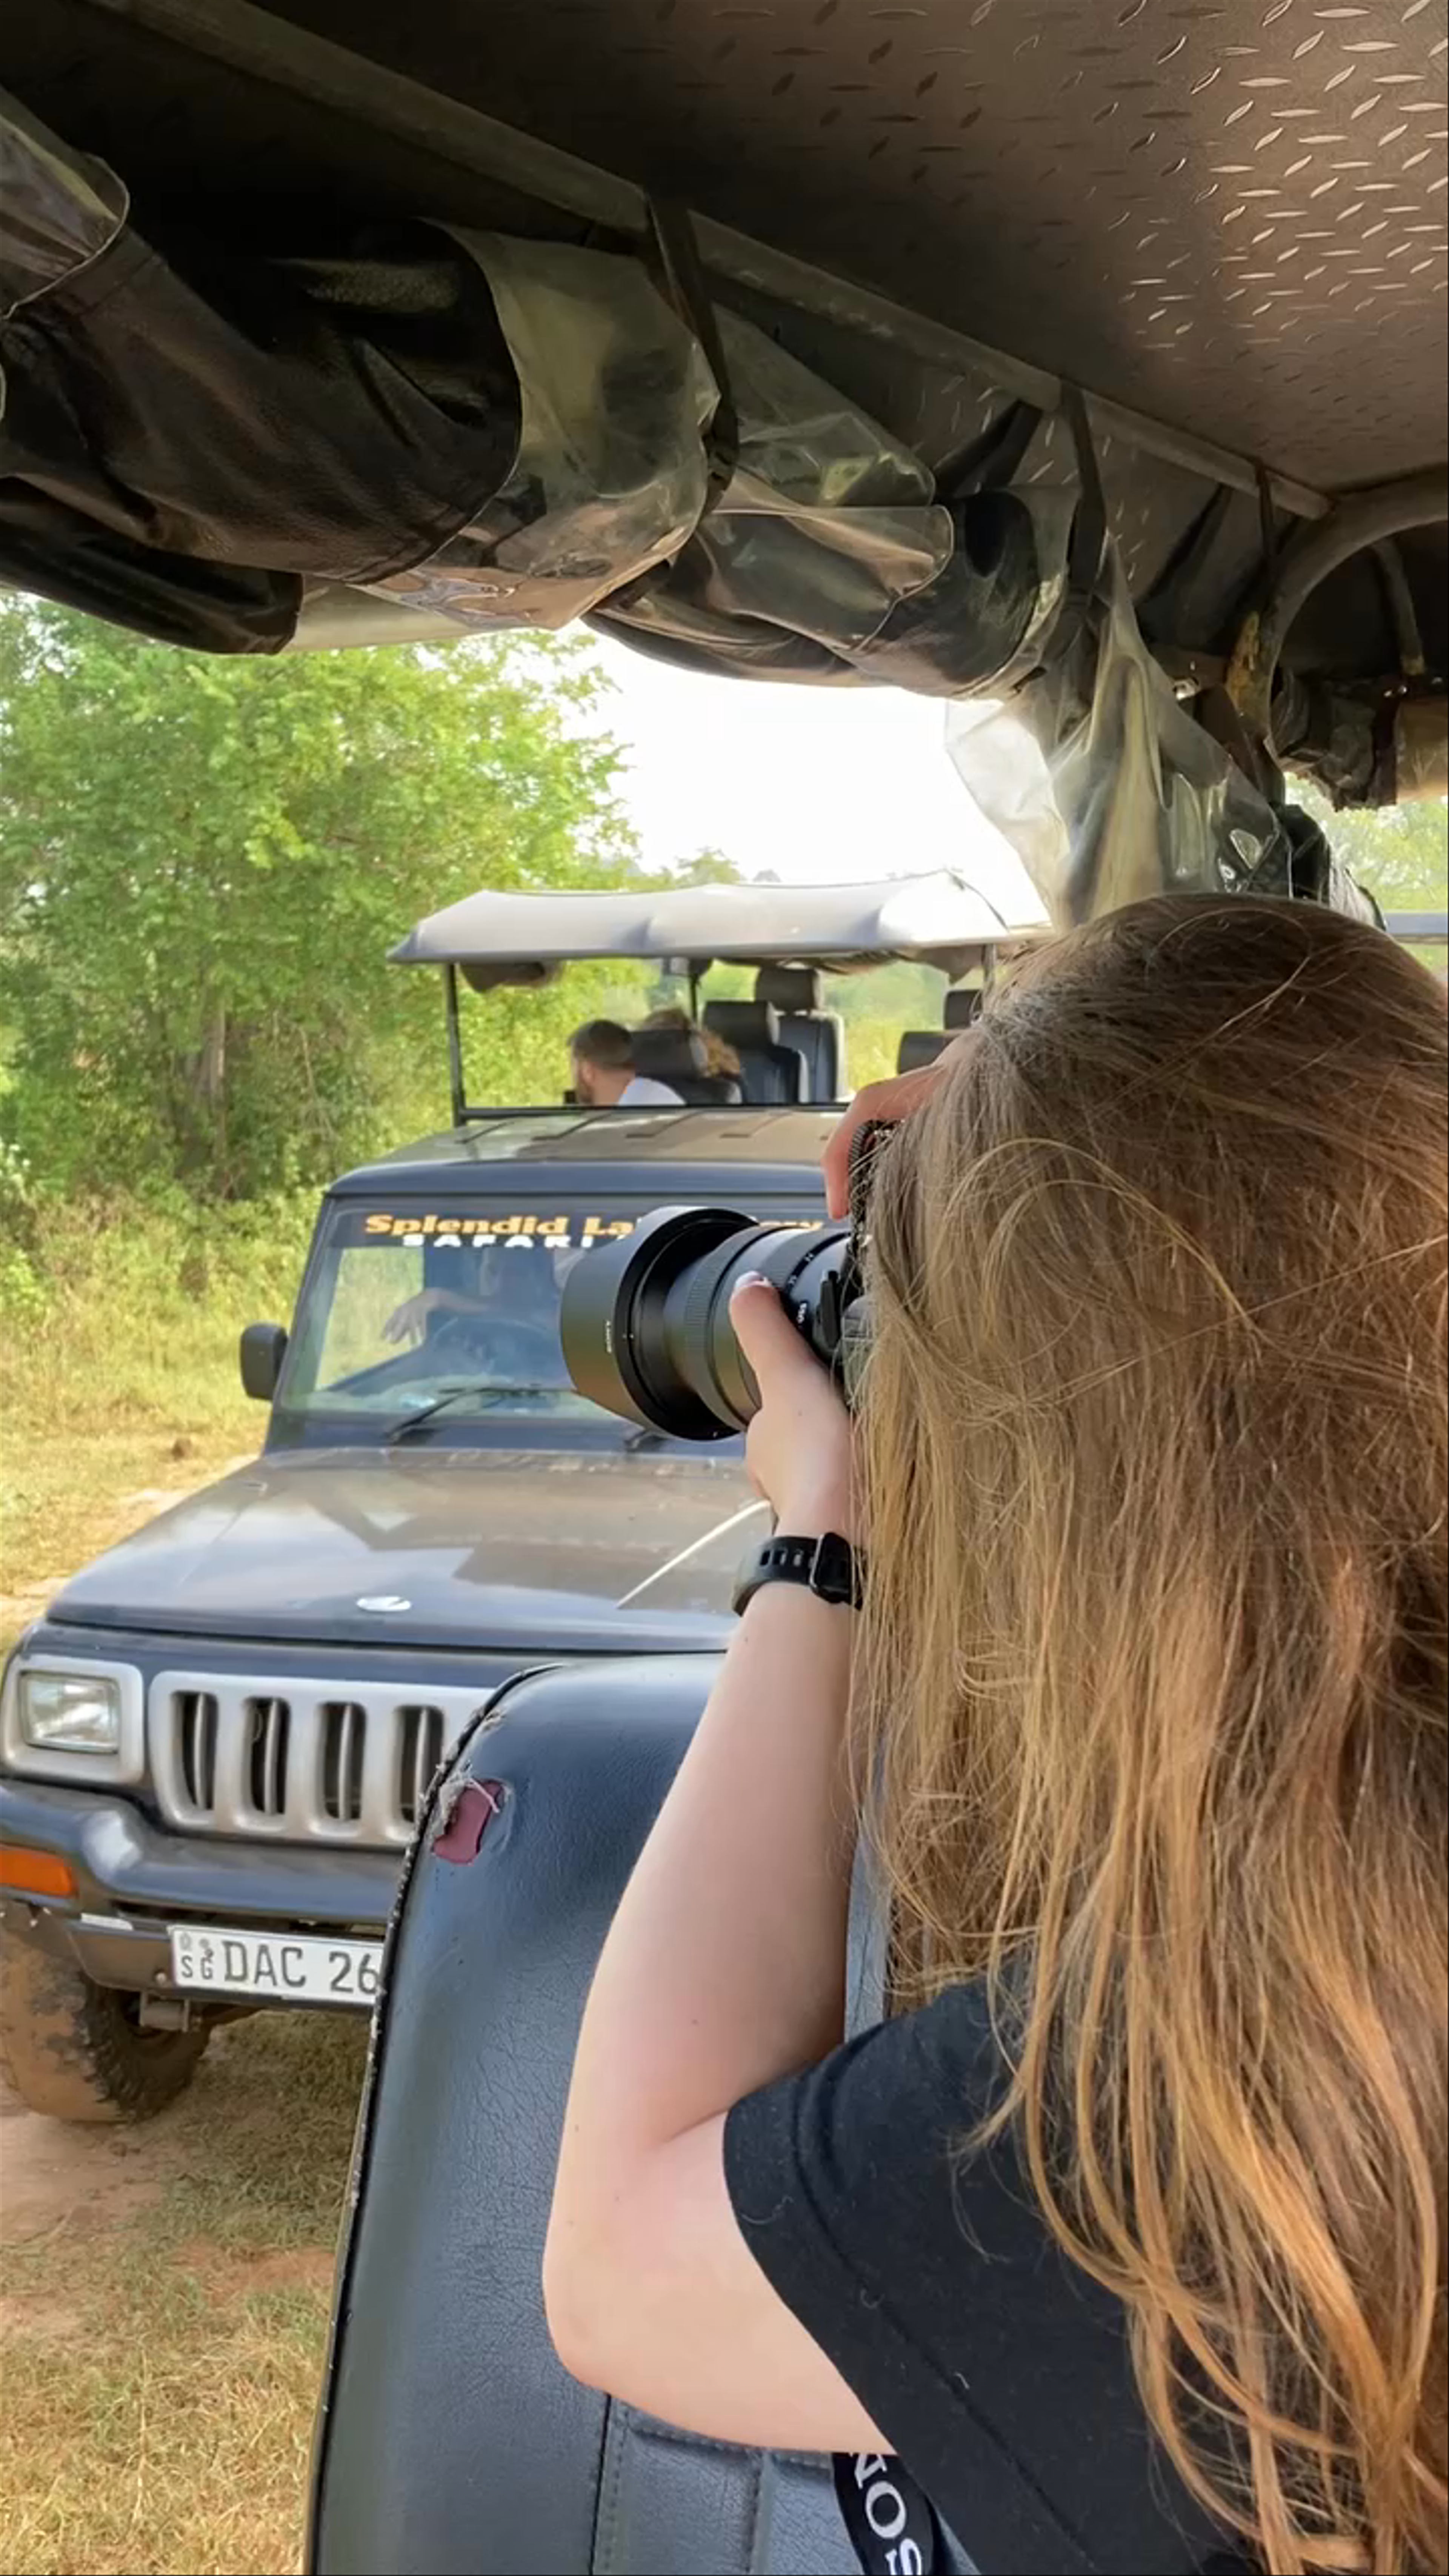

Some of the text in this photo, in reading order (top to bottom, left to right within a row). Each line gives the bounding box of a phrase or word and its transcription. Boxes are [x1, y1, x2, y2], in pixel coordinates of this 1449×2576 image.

[365, 1214, 635, 1236] Splendid La
[181, 1940, 379, 1995] SG DAC 26
